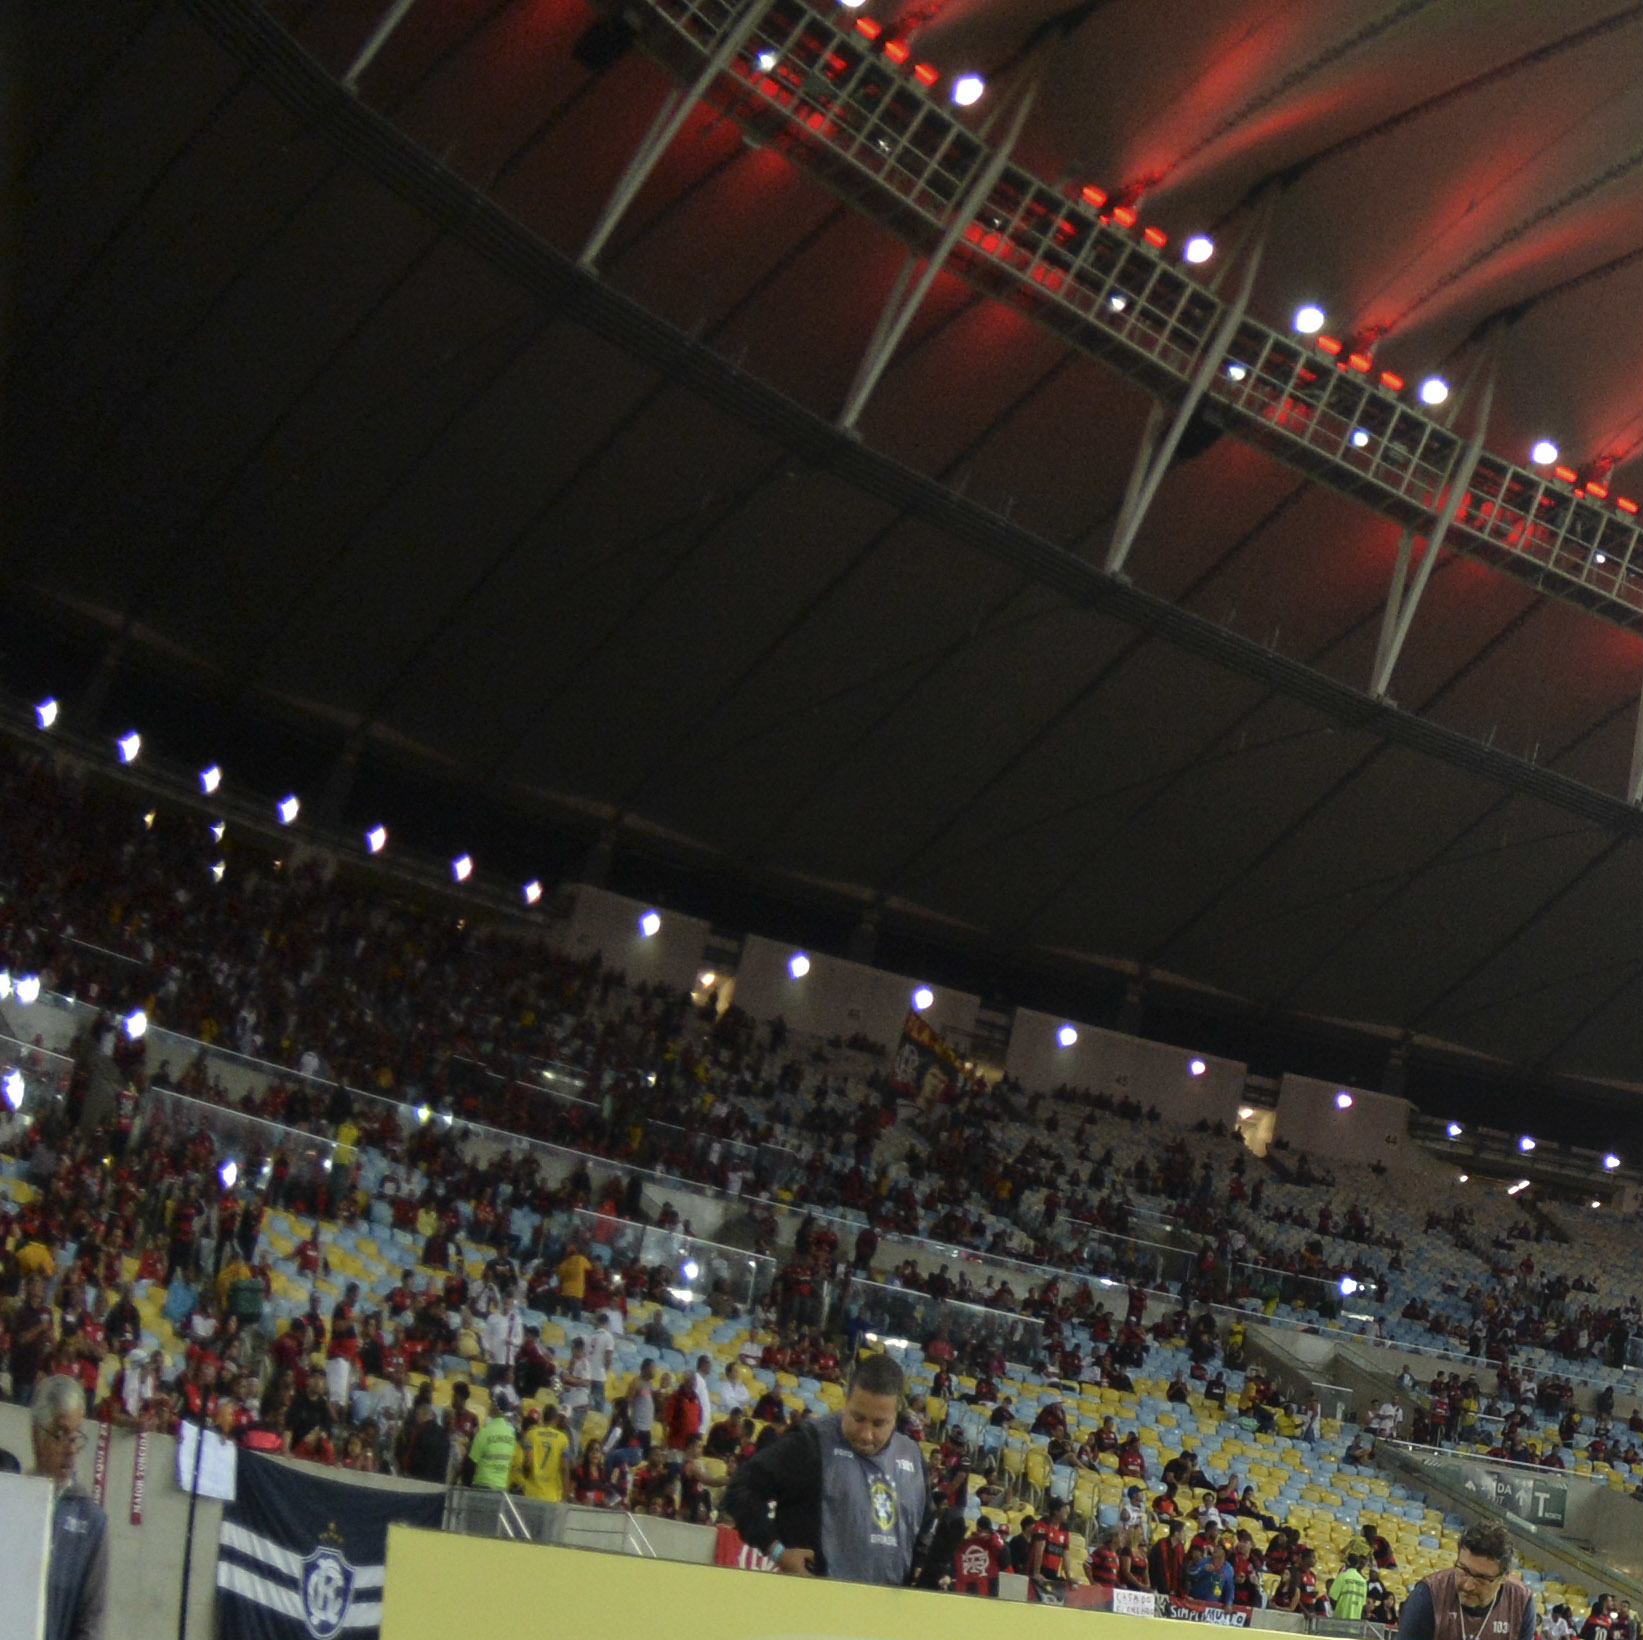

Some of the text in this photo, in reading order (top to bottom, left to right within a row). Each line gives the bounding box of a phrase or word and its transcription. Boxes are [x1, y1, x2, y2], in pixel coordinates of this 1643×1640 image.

[136, 1433, 149, 1477] TORCIDA
[1534, 1491, 1550, 1518] T
[1493, 1621, 1509, 1634] 103
